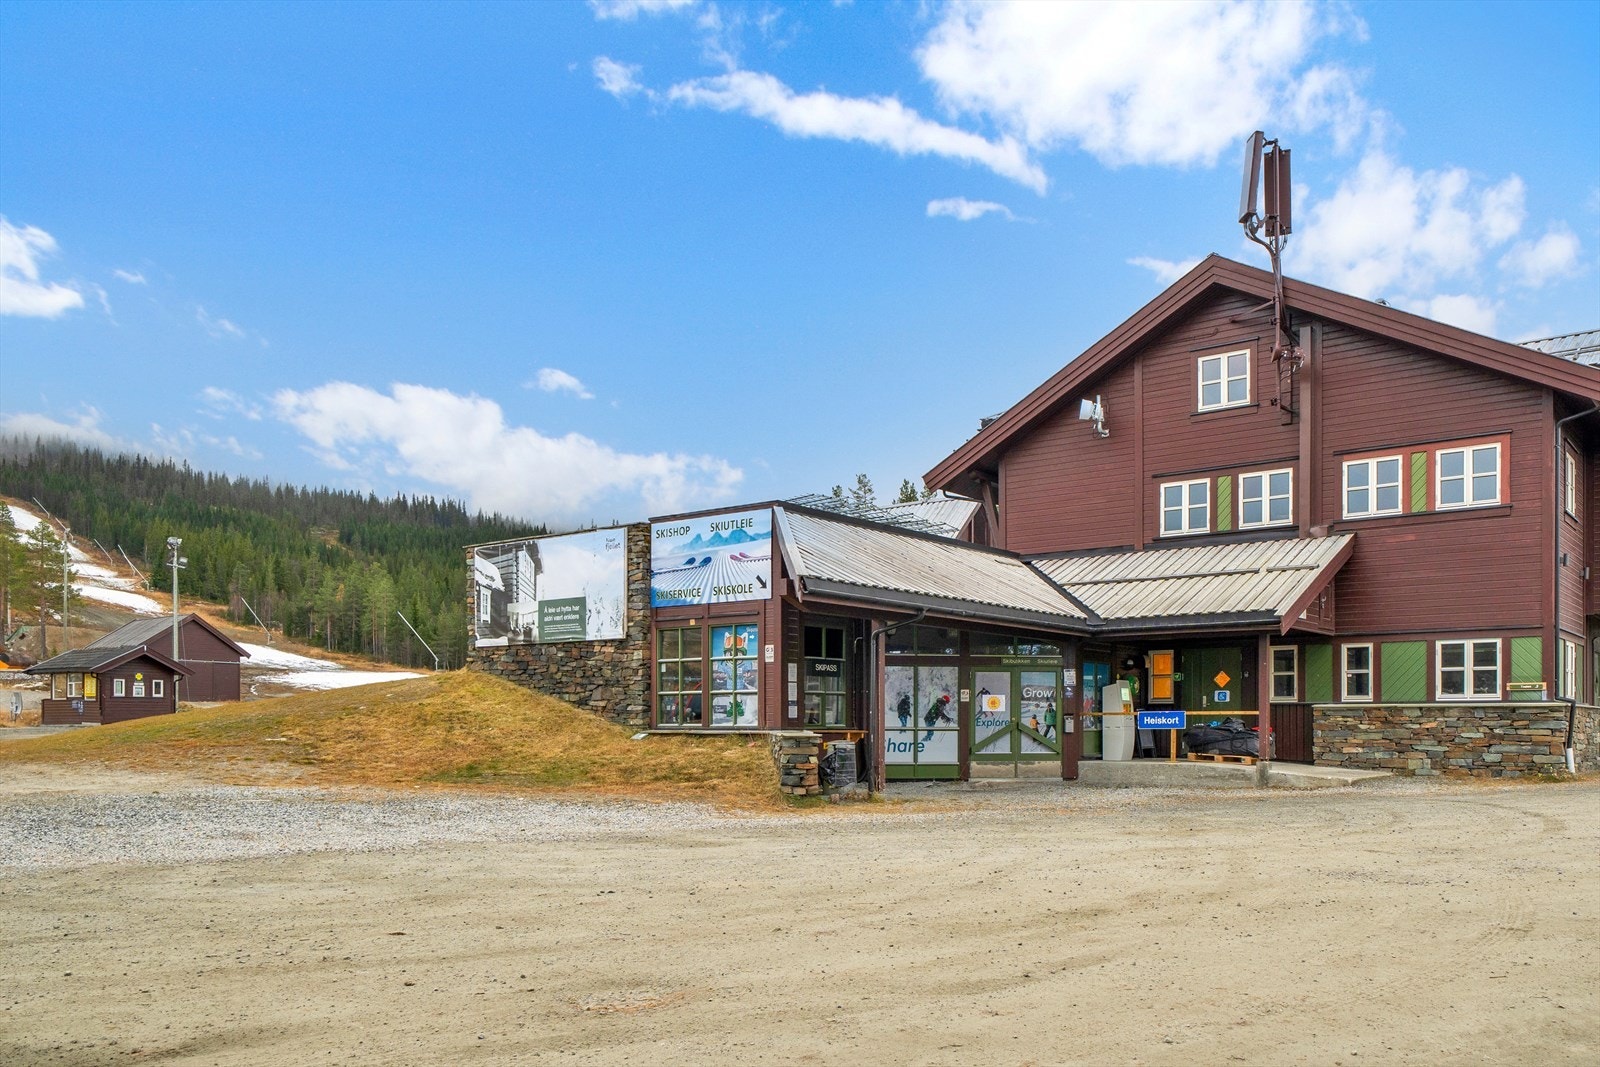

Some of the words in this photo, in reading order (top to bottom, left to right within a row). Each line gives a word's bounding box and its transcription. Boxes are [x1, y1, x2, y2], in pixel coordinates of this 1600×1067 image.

[710, 518, 753, 532] SKIUTLEIE
[656, 526, 690, 538] SKISHOP
[656, 588, 702, 600] SKISERVICE
[713, 584, 753, 596] SKISKOLE
[815, 664, 837, 672] SKIPASS
[1022, 687, 1053, 698] Grow
[976, 717, 1010, 729] Explore
[1144, 716, 1179, 725] Heiskort
[884, 738, 925, 752] hare
